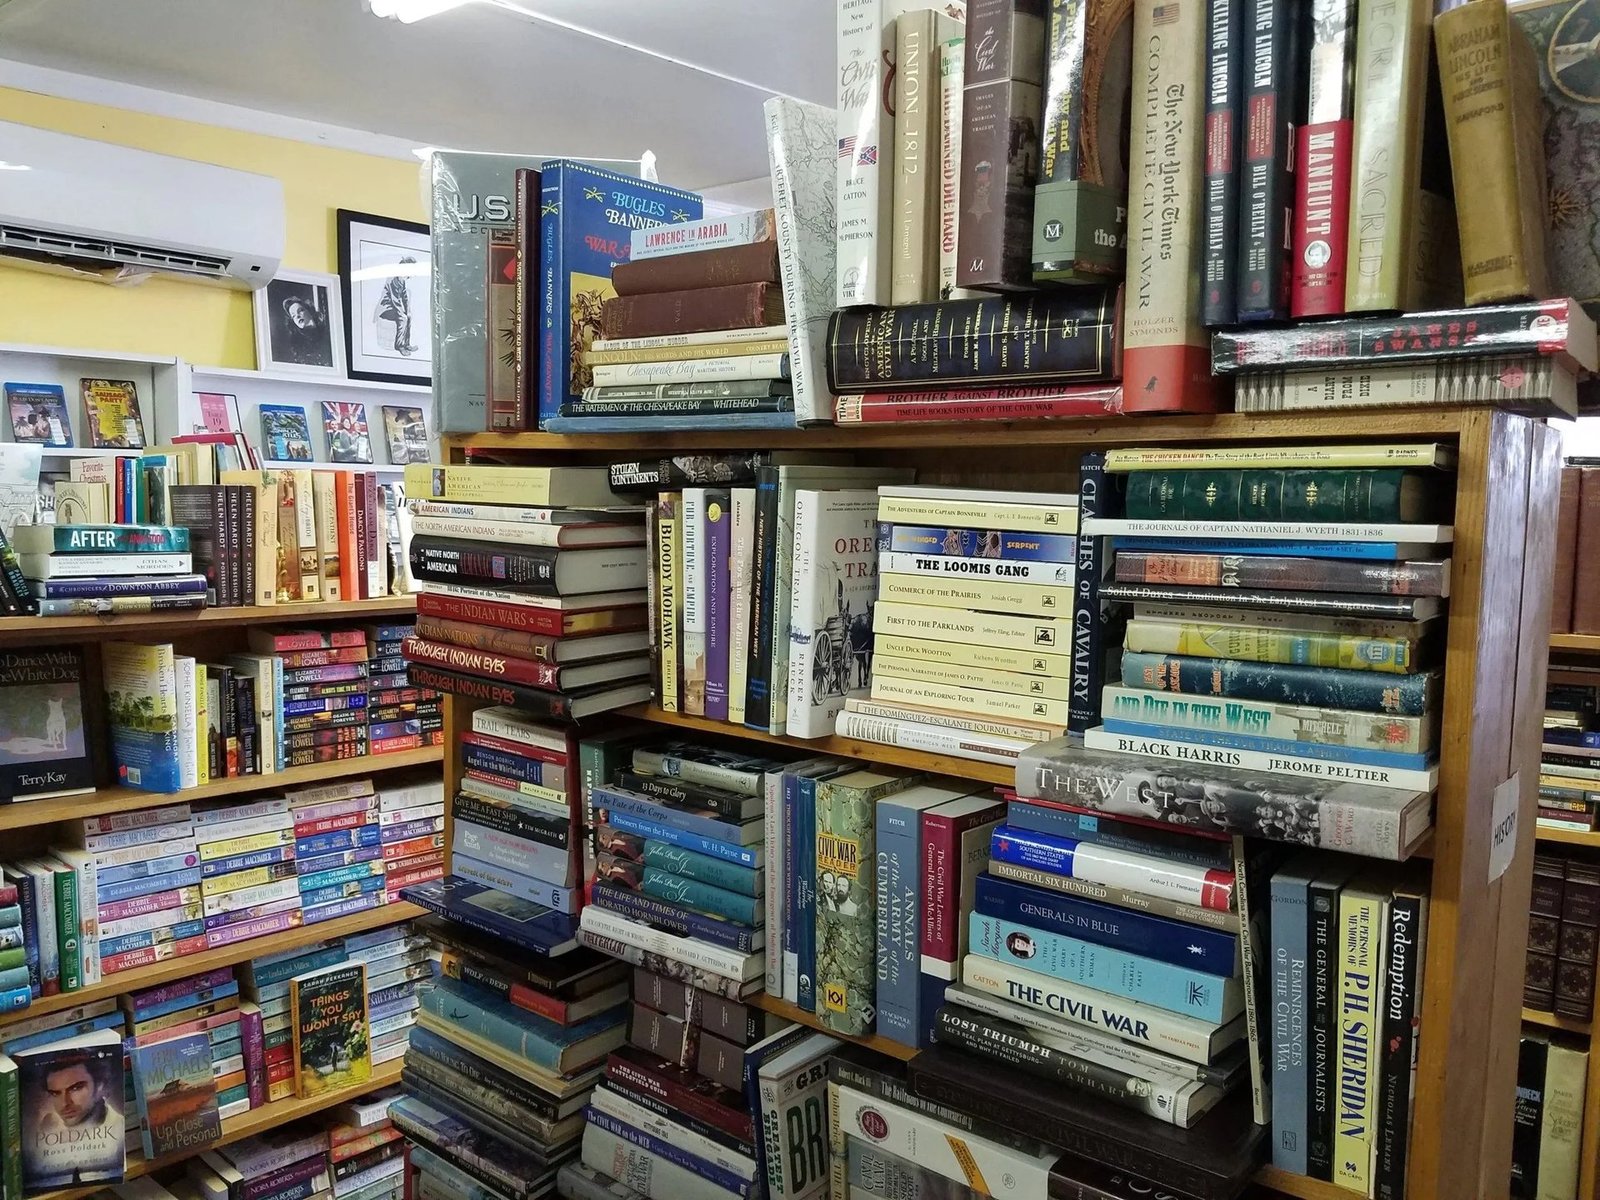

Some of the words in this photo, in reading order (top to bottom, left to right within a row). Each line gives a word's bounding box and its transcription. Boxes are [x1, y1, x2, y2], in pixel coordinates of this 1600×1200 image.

[975, 36, 999, 57] Civil
[976, 56, 995, 72] War
[1254, 34, 1273, 88] LINCOLN
[1211, 53, 1229, 105] LINCOLN
[1165, 83, 1185, 117] The
[1159, 158, 1182, 205] York
[1210, 179, 1225, 203] BILL
[1305, 131, 1335, 235] MANHUNT
[451, 195, 515, 221] U.S.
[611, 191, 666, 217] BUGLES
[1358, 149, 1388, 279] SACRED
[1140, 182, 1156, 253] CIVIL
[1209, 205, 1225, 250] O'REILLY
[645, 230, 686, 248] LAWRENCE
[688, 230, 696, 239] IN
[697, 223, 728, 241] ARABIA
[780, 212, 792, 263] COUNTY
[1159, 206, 1181, 261] Times
[785, 265, 797, 309] DURING
[1138, 256, 1152, 311] WAR
[790, 312, 798, 331] THE
[1129, 326, 1179, 337] SYMONDS
[1133, 316, 1176, 326] HOLZER
[791, 334, 801, 369] CIVIL
[627, 361, 675, 381] Chesapeake
[676, 363, 697, 377] Bay
[796, 371, 804, 395] WAR
[886, 389, 950, 404] BROTHER
[951, 389, 995, 401] AGAINST
[996, 385, 1067, 400] BROTHER
[1324, 376, 1335, 401] DIARY
[1342, 375, 1353, 399] FROM
[1360, 374, 1371, 398] DIXIE
[572, 403, 584, 413] THE
[585, 402, 618, 413] WATERMEN
[629, 402, 643, 412] THE
[643, 401, 686, 412] CHESAPEAKE
[687, 401, 702, 411] BAY
[713, 398, 759, 409] WHITEHEAD
[82, 462, 104, 473] Favorite
[611, 462, 640, 474] STOLEN
[611, 472, 659, 486] CONTINENTS
[421, 505, 450, 516] AMERICAN
[451, 507, 474, 516] INDIANS
[70, 530, 116, 548] AFTER
[415, 521, 424, 530] THE
[424, 522, 443, 533] NORTH
[443, 525, 472, 534] AMERICAN
[472, 526, 496, 536] INDIANS
[794, 501, 804, 563] OREGON
[1127, 523, 1144, 532] THE
[1145, 523, 1189, 533] JOURNALS
[1201, 525, 1239, 535] CAPTAIN
[1241, 525, 1294, 536] NATHANIEL
[1306, 526, 1339, 536] WYETH
[1340, 527, 1384, 537] 1831-1836
[425, 549, 443, 559] NATIVE
[443, 550, 460, 560] NORTH
[660, 524, 673, 582] BLOODY
[1006, 541, 1040, 551] SERPENT
[426, 561, 458, 574] AMERICAN
[916, 559, 940, 571] THE
[944, 561, 991, 574] LOOMIS
[995, 564, 1030, 577] GANG
[108, 582, 152, 593] DOWNTON
[154, 580, 180, 591] ABBEY
[793, 566, 802, 610] TRAIL
[888, 584, 926, 596] COMMERCE
[950, 589, 982, 600] PRAIRIES
[1080, 582, 1090, 600] OF
[446, 603, 460, 613] THE
[461, 603, 496, 621] INDIAN
[498, 609, 527, 626] WARS
[662, 584, 675, 650] MOHAWK
[887, 616, 905, 626] FIRST
[906, 619, 916, 627] TO
[917, 620, 931, 629] THE
[932, 620, 975, 633] PARKLANDS
[417, 623, 447, 638] INDIAN
[448, 628, 478, 645] NATIONS
[302, 657, 328, 666] LOWELL
[408, 638, 448, 663] THROUGH
[449, 648, 483, 669] INDIAN
[484, 657, 505, 674] EYES
[886, 643, 904, 652] UNCLE
[905, 645, 920, 654] DICK
[921, 647, 952, 658] WOOTTON
[1074, 608, 1092, 702] CAVALRY
[296, 675, 322, 683] LOWELL
[410, 668, 452, 693] THROUGH
[454, 679, 491, 698] INDIAN
[492, 687, 516, 705] EYES
[846, 717, 899, 744] STAGECOACH
[863, 706, 878, 715] THE
[974, 722, 1011, 736] JOURNAL
[1191, 704, 1221, 727] THE
[1225, 703, 1271, 734] WEST
[1117, 738, 1171, 757] BLACK
[1175, 746, 1241, 766] HARRIS
[1267, 758, 1323, 775] JEROME
[1327, 766, 1389, 783] PELTIER
[18, 773, 46, 786] Terry
[46, 772, 67, 783] Kay
[1036, 768, 1091, 796] THE
[1096, 776, 1176, 809] WEST
[818, 837, 836, 860] CIVIL
[837, 841, 857, 863] WAR
[818, 855, 856, 871] READER
[998, 865, 1044, 886] IMMORTAL
[1045, 876, 1060, 889] SIX
[1062, 879, 1107, 899] HUNDRED
[1121, 894, 1151, 909] Murray
[597, 898, 630, 914] HORATIO
[631, 908, 688, 932] HORNBLOWER
[877, 851, 888, 981] CUMBERLAND
[890, 898, 901, 945] ARMY
[905, 886, 915, 962] ANNALS
[1020, 902, 1074, 927] GENERALS
[1077, 915, 1088, 928] IN
[1091, 919, 1120, 936] BLUE
[1277, 948, 1287, 966] OF
[1389, 907, 1412, 1020] Redemption
[973, 973, 999, 988] CATTON
[1277, 969, 1287, 995] THE
[1316, 949, 1328, 1008] GENERAL
[310, 990, 350, 1007] THINGS
[320, 1003, 343, 1016] YOU
[1006, 979, 1043, 1006] THE
[1045, 993, 1099, 1025] CIVIL
[1102, 1009, 1150, 1041] WAR
[302, 1015, 339, 1033] WON'T
[341, 1010, 362, 1023] SAY
[1277, 997, 1291, 1040] CIVIL
[1291, 958, 1305, 1067] REMINISCENCES
[942, 1012, 979, 1033] LOST
[983, 1027, 1052, 1059] TRIUMPH
[1059, 1056, 1090, 1073] TOM
[1276, 1043, 1291, 1072] WAR
[1313, 1026, 1327, 1112] JOURNALISTS
[1056, 1069, 1129, 1098] CARHART
[1340, 1018, 1369, 1142] SHERIDAN
[35, 1125, 118, 1147] POLDARK
[156, 1125, 172, 1140] Up
[174, 1116, 204, 1134] Close
[176, 1124, 220, 1148] Personal
[43, 1149, 66, 1157] Ross
[70, 1142, 106, 1153] Poldark
